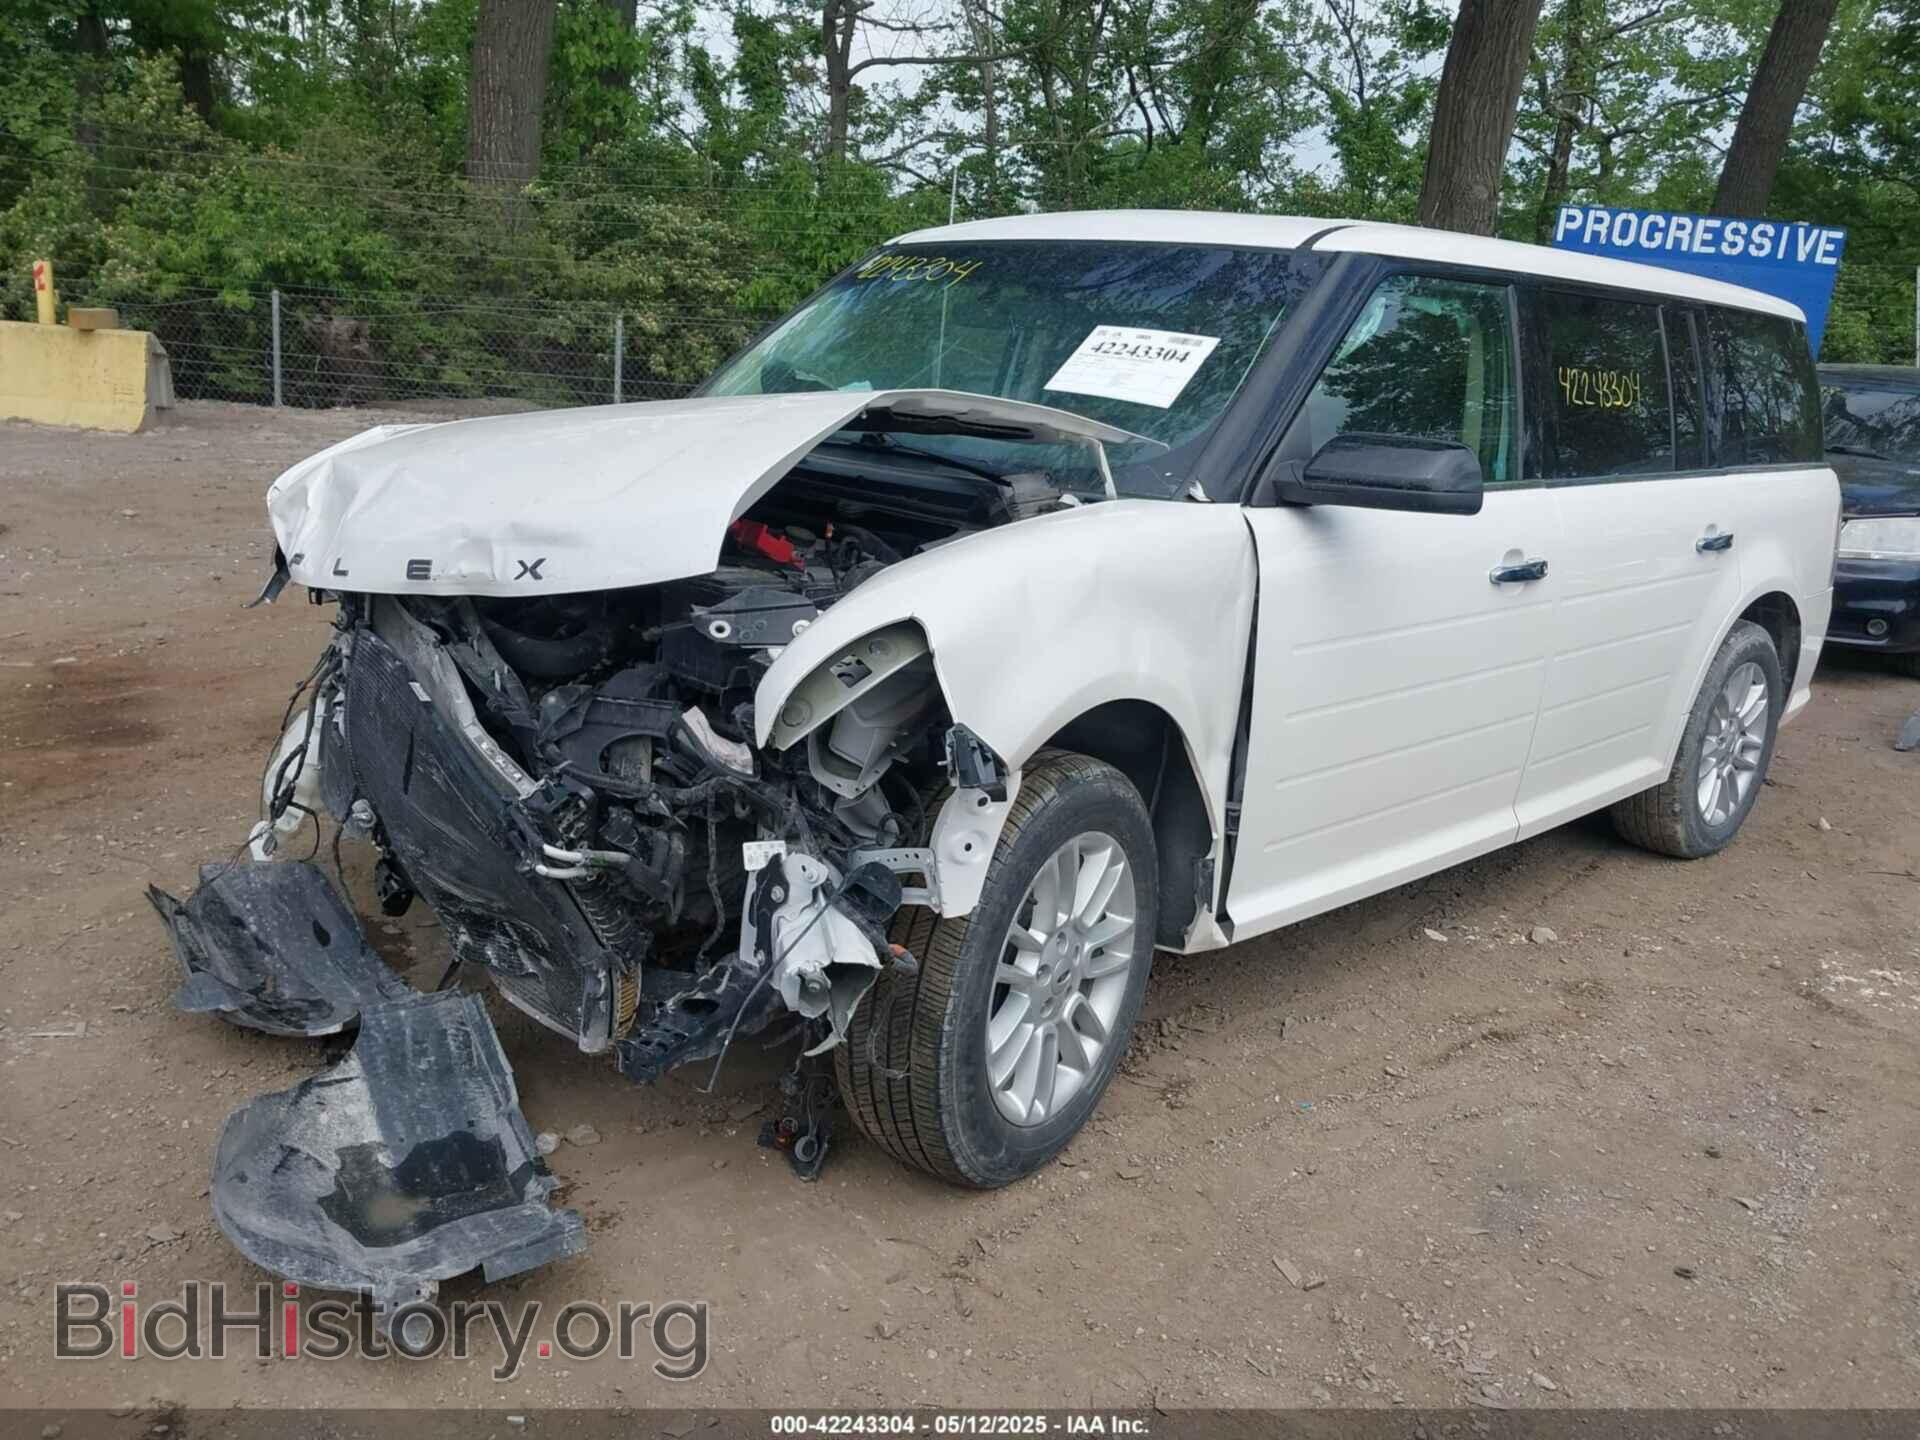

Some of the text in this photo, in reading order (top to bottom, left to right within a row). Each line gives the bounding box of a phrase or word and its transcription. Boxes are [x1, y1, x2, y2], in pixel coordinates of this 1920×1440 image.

[1556, 207, 1845, 265] PROGRESSIVE
[1090, 341, 1191, 363] 42243304
[1558, 366, 1641, 408] 42243304
